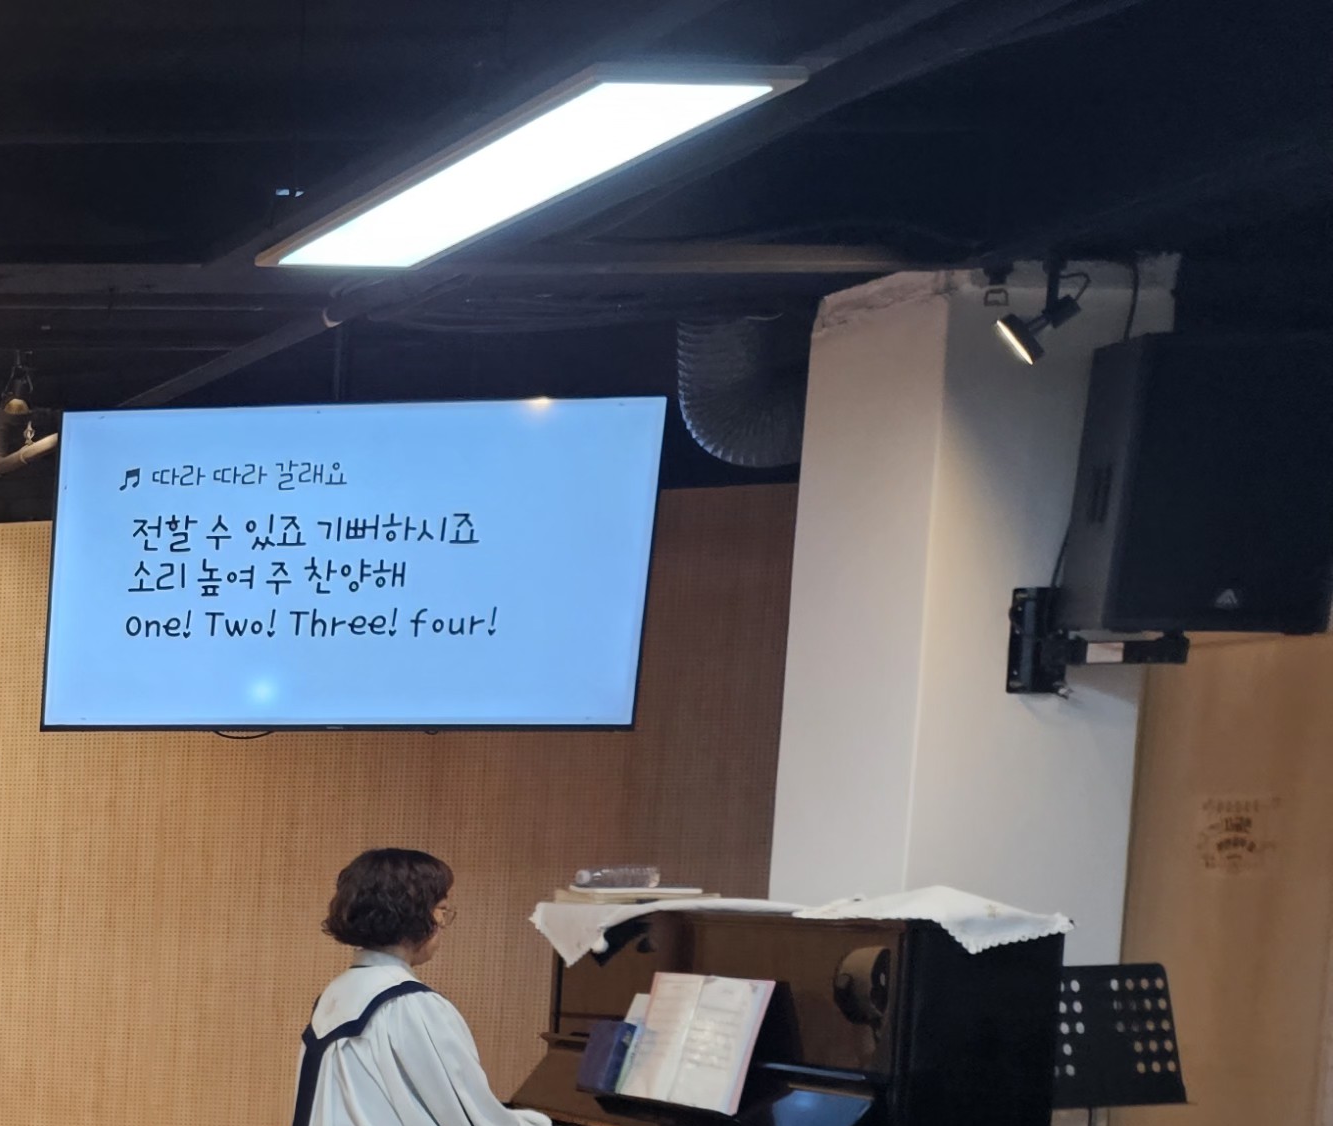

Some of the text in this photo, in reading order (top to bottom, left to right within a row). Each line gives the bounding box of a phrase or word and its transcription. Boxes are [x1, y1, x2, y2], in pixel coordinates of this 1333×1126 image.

[151, 459, 348, 491] 따라 따라 갈래요
[132, 512, 480, 553] 전할 수 있죠 기뻐하시죠
[127, 556, 407, 598] 소리 높여 주 찬양해
[204, 608, 277, 639] Two!
[289, 607, 398, 638] Three!
[409, 605, 498, 638] four!
